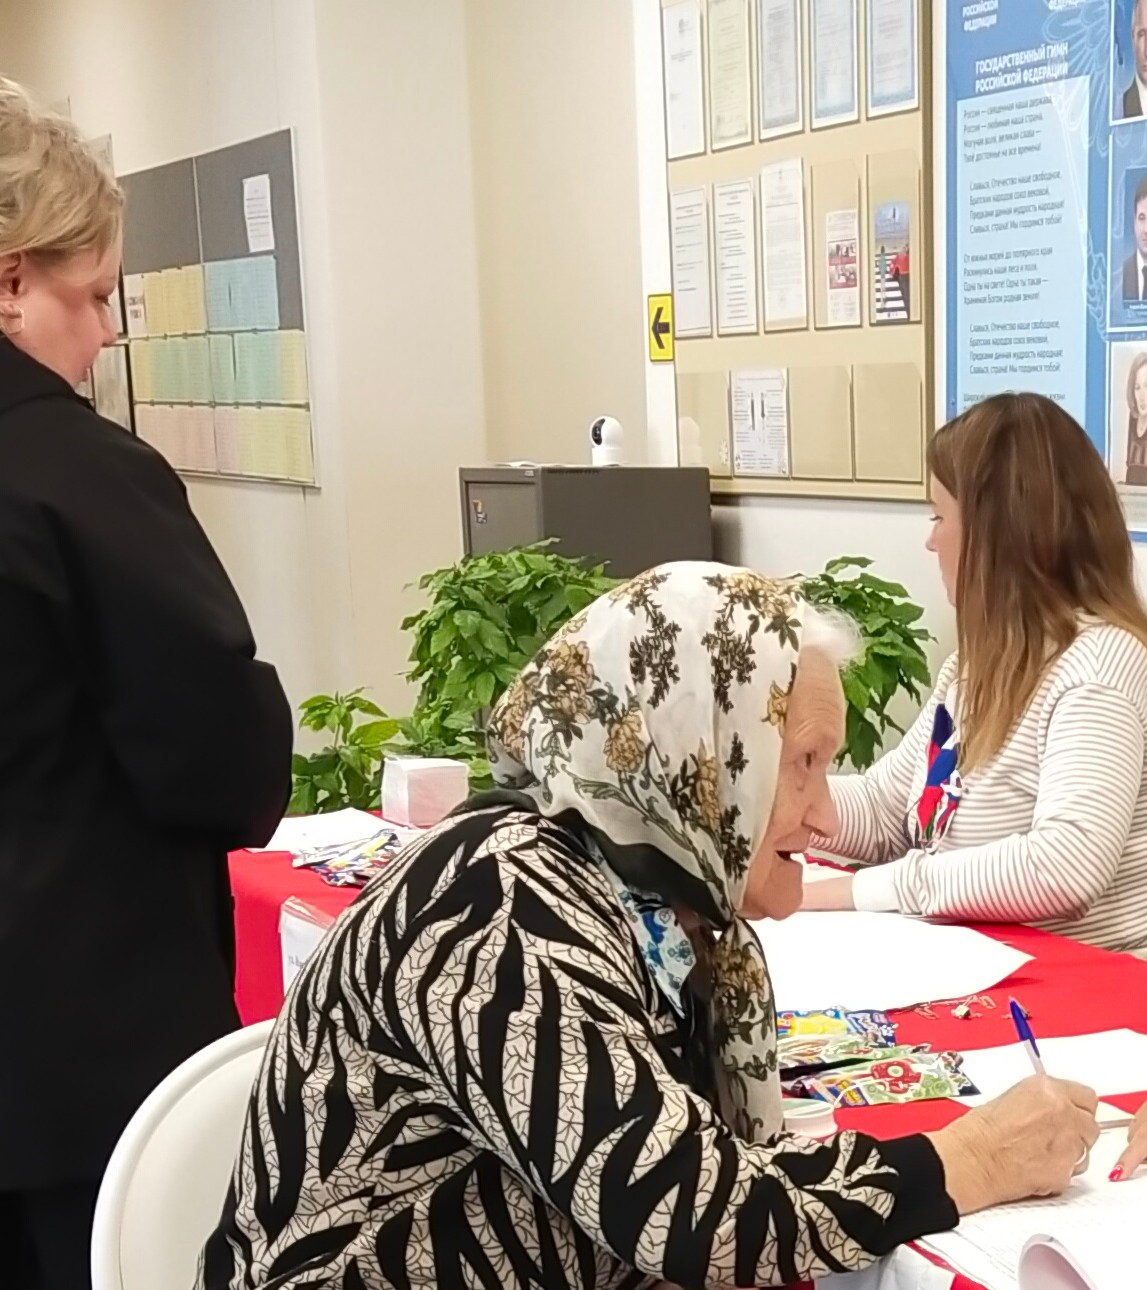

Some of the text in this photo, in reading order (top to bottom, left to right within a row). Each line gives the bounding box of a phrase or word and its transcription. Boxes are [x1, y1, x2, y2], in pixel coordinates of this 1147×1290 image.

[976, 42, 1068, 74] ГОСУДАРСТВЕННЫЙ ГИМН
[976, 62, 1068, 94] РОССИЙСКОЙ ФЕДЕРАЦИИ
